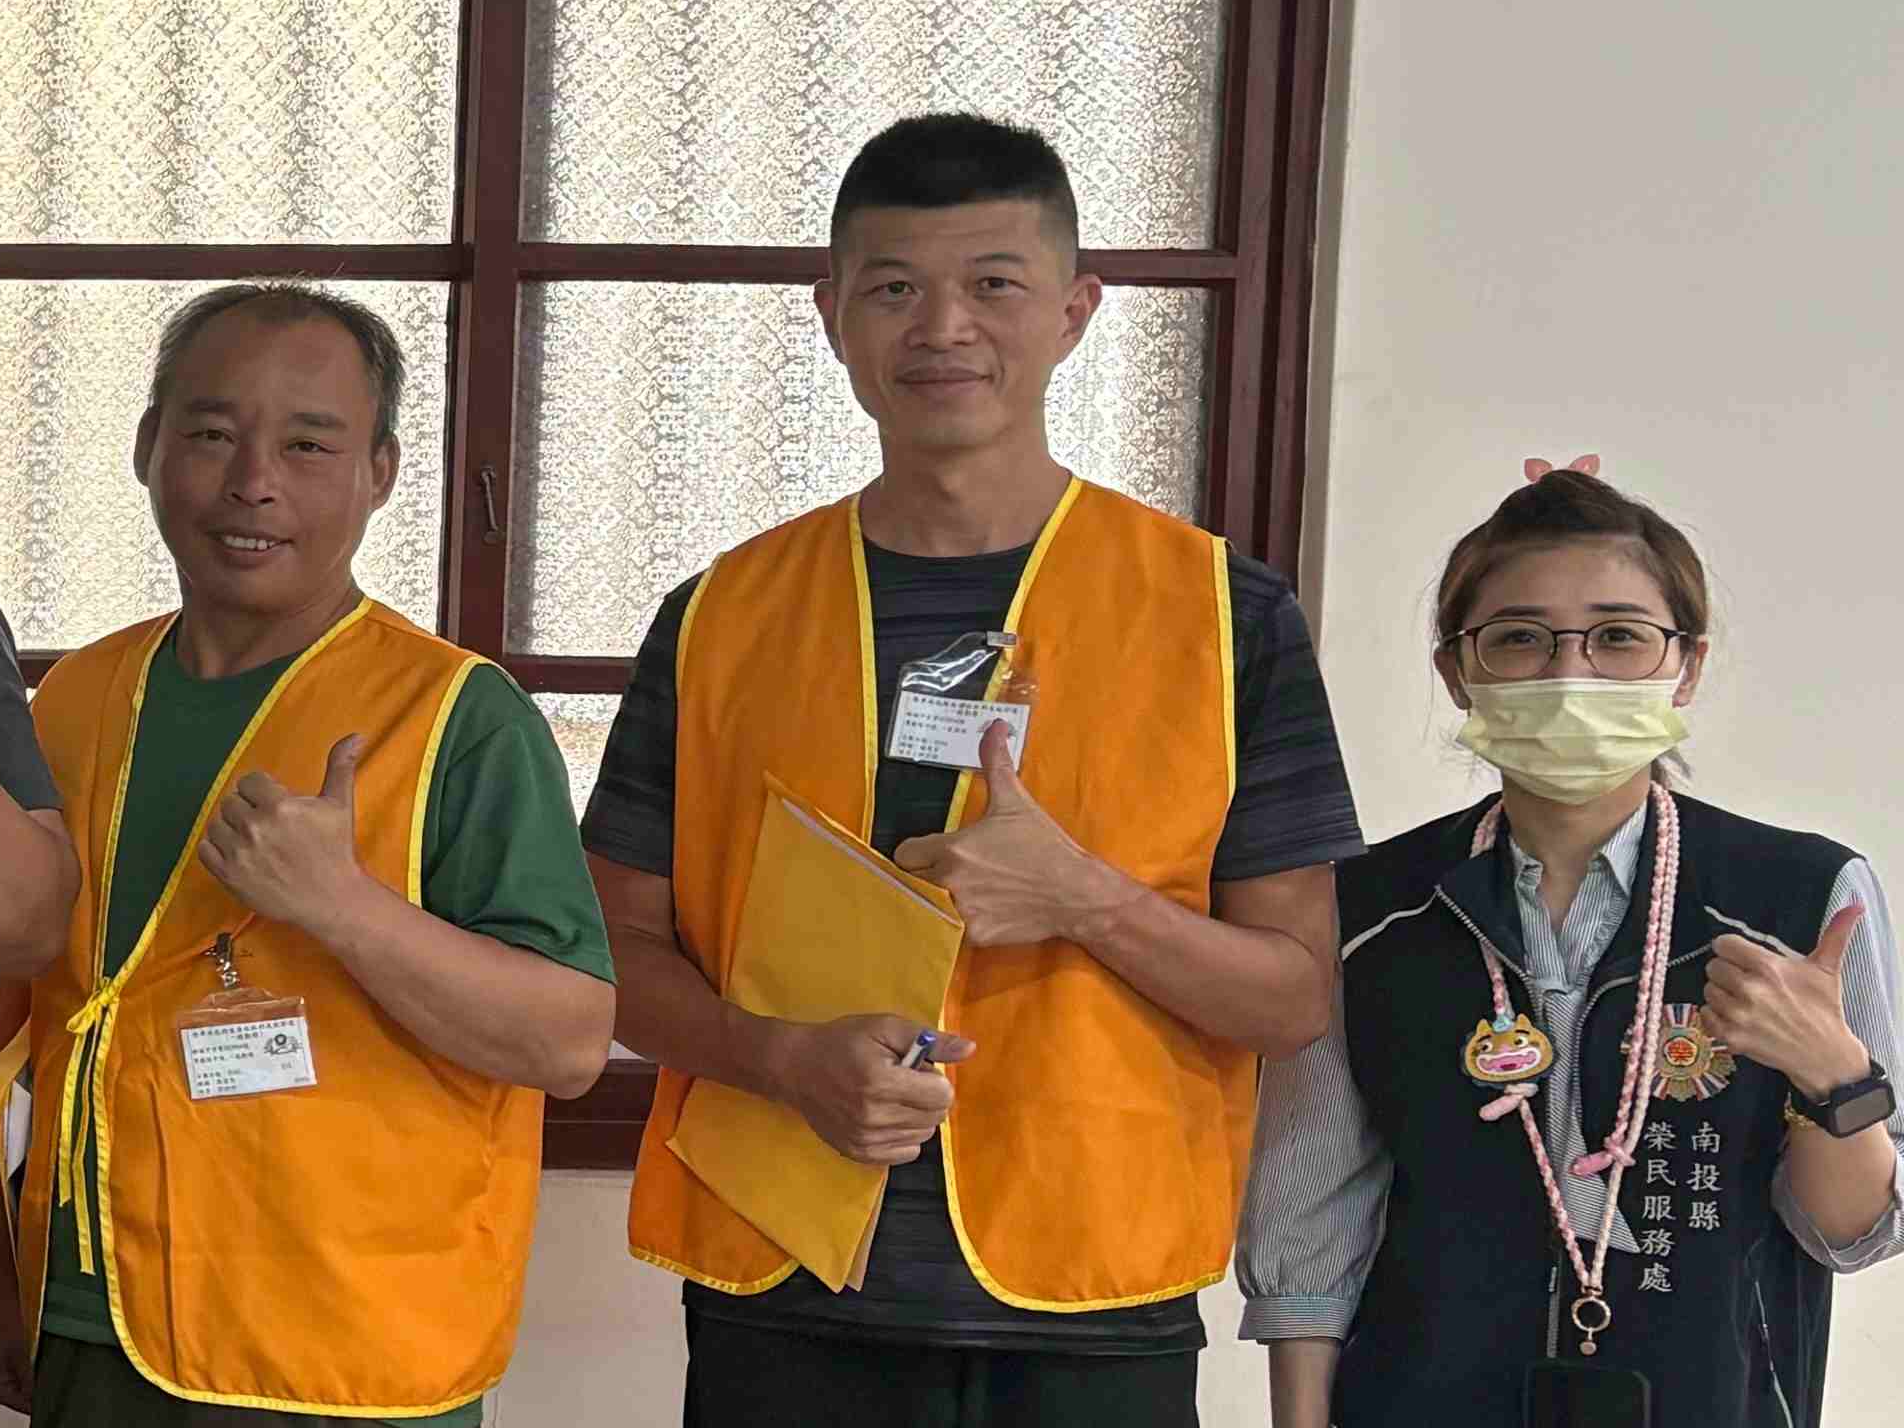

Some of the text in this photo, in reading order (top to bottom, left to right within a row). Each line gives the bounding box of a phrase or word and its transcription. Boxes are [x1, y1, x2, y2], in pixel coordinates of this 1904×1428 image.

[1638, 1121, 1678, 1293] 榮民服務處
[1685, 1121, 1724, 1232] 南投縣
